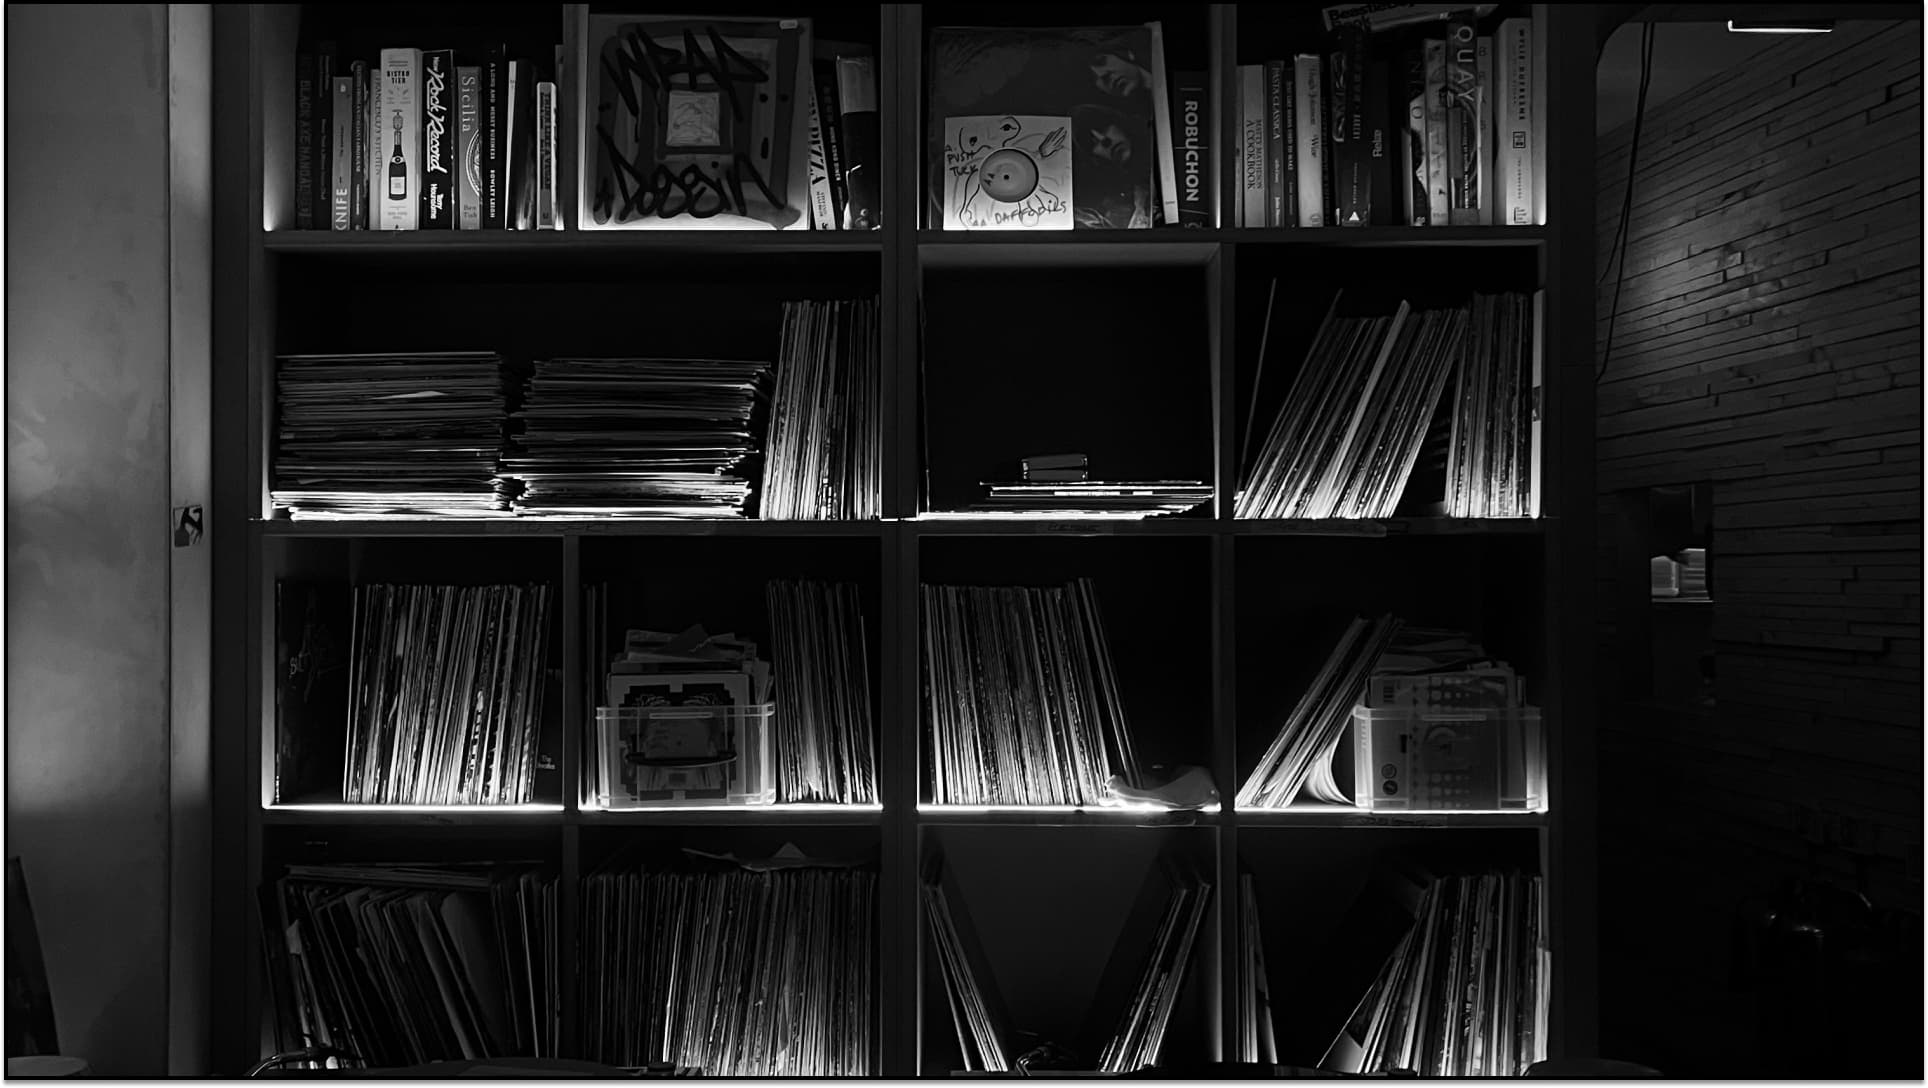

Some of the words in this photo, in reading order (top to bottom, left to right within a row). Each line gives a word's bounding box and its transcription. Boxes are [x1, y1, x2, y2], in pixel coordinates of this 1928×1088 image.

[426, 66, 447, 112] Rock
[1456, 26, 1474, 101] QUAY
[461, 75, 476, 132] Sicilia
[426, 111, 448, 174] Record
[1185, 100, 1200, 202] ROBUCHON
[1247, 129, 1256, 190] COOKBOOK
